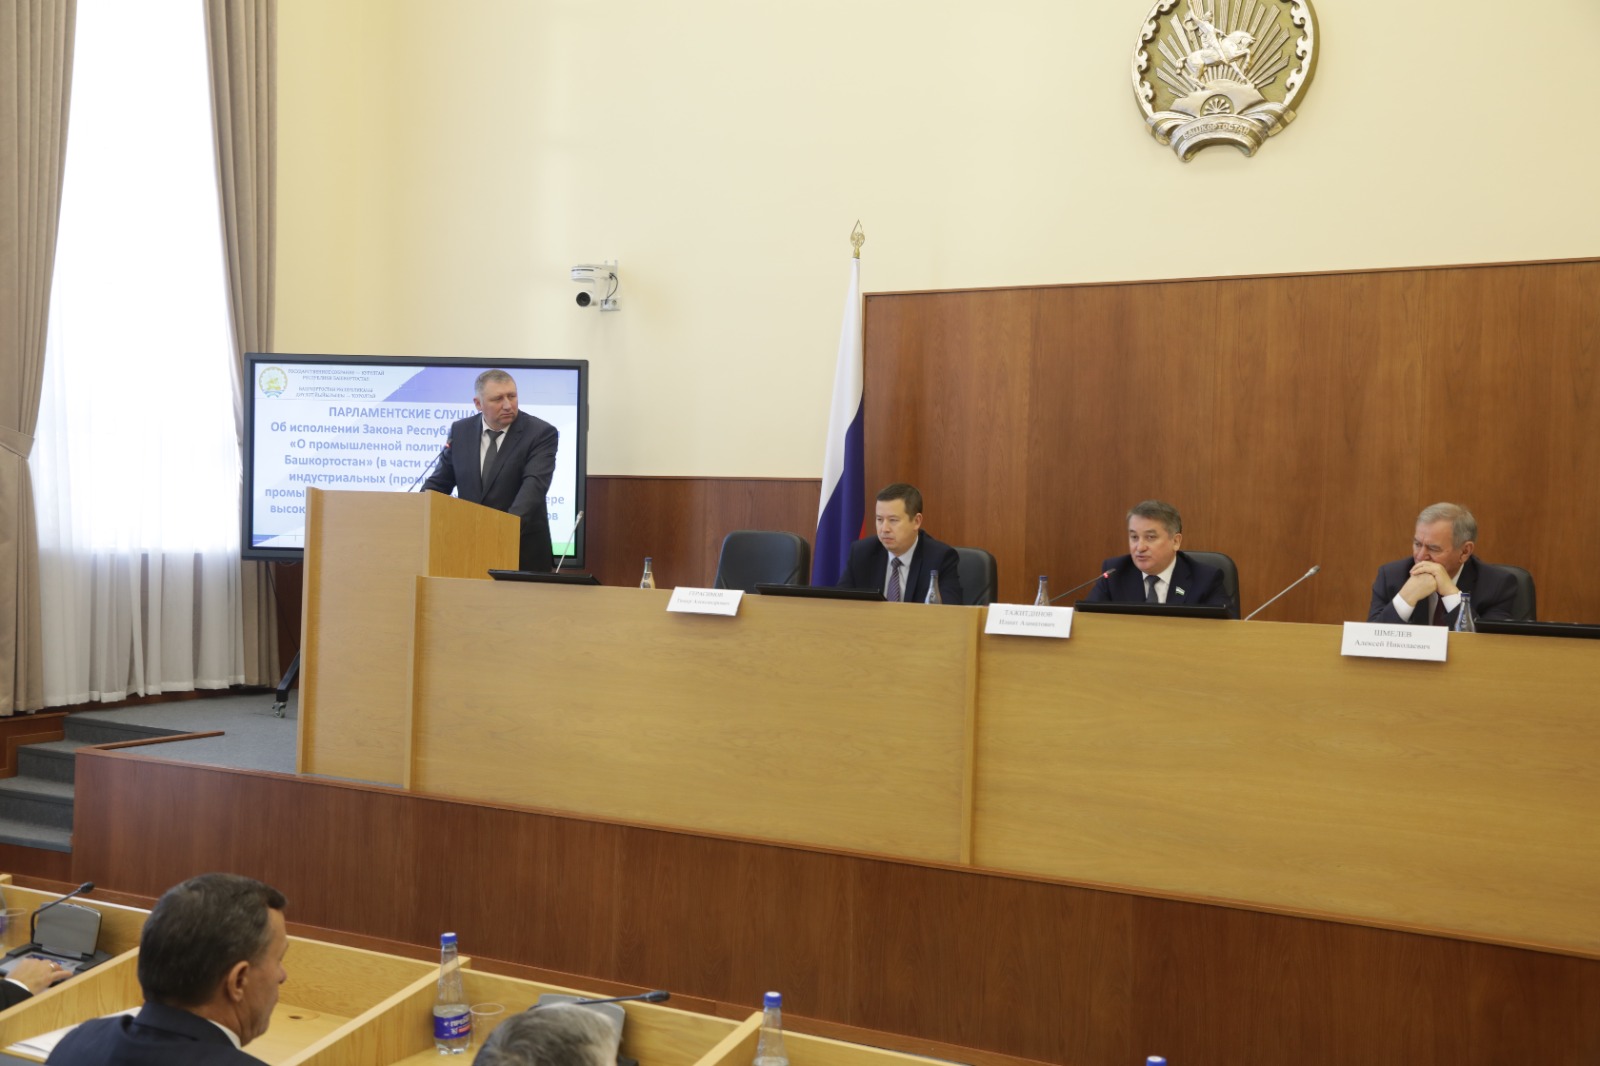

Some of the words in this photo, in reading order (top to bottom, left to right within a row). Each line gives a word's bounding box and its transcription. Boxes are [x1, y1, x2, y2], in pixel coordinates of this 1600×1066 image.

[329, 406, 431, 419] ПАРЛАМЕНТСКИЕ
[270, 422, 286, 432] Об
[290, 424, 360, 434] исполнении
[363, 424, 403, 434] Закона
[290, 438, 306, 448] «О
[309, 440, 402, 453] промышленной
[285, 454, 372, 468] Башкортостан»
[376, 456, 387, 469] (в
[390, 459, 420, 468] части
[288, 472, 386, 484] индустриальных
[265, 488, 305, 500] промы
[1374, 629, 1412, 638] ШМЕЛЕВ
[1354, 640, 1384, 648] Алексей
[1386, 641, 1430, 650] Николаевич
